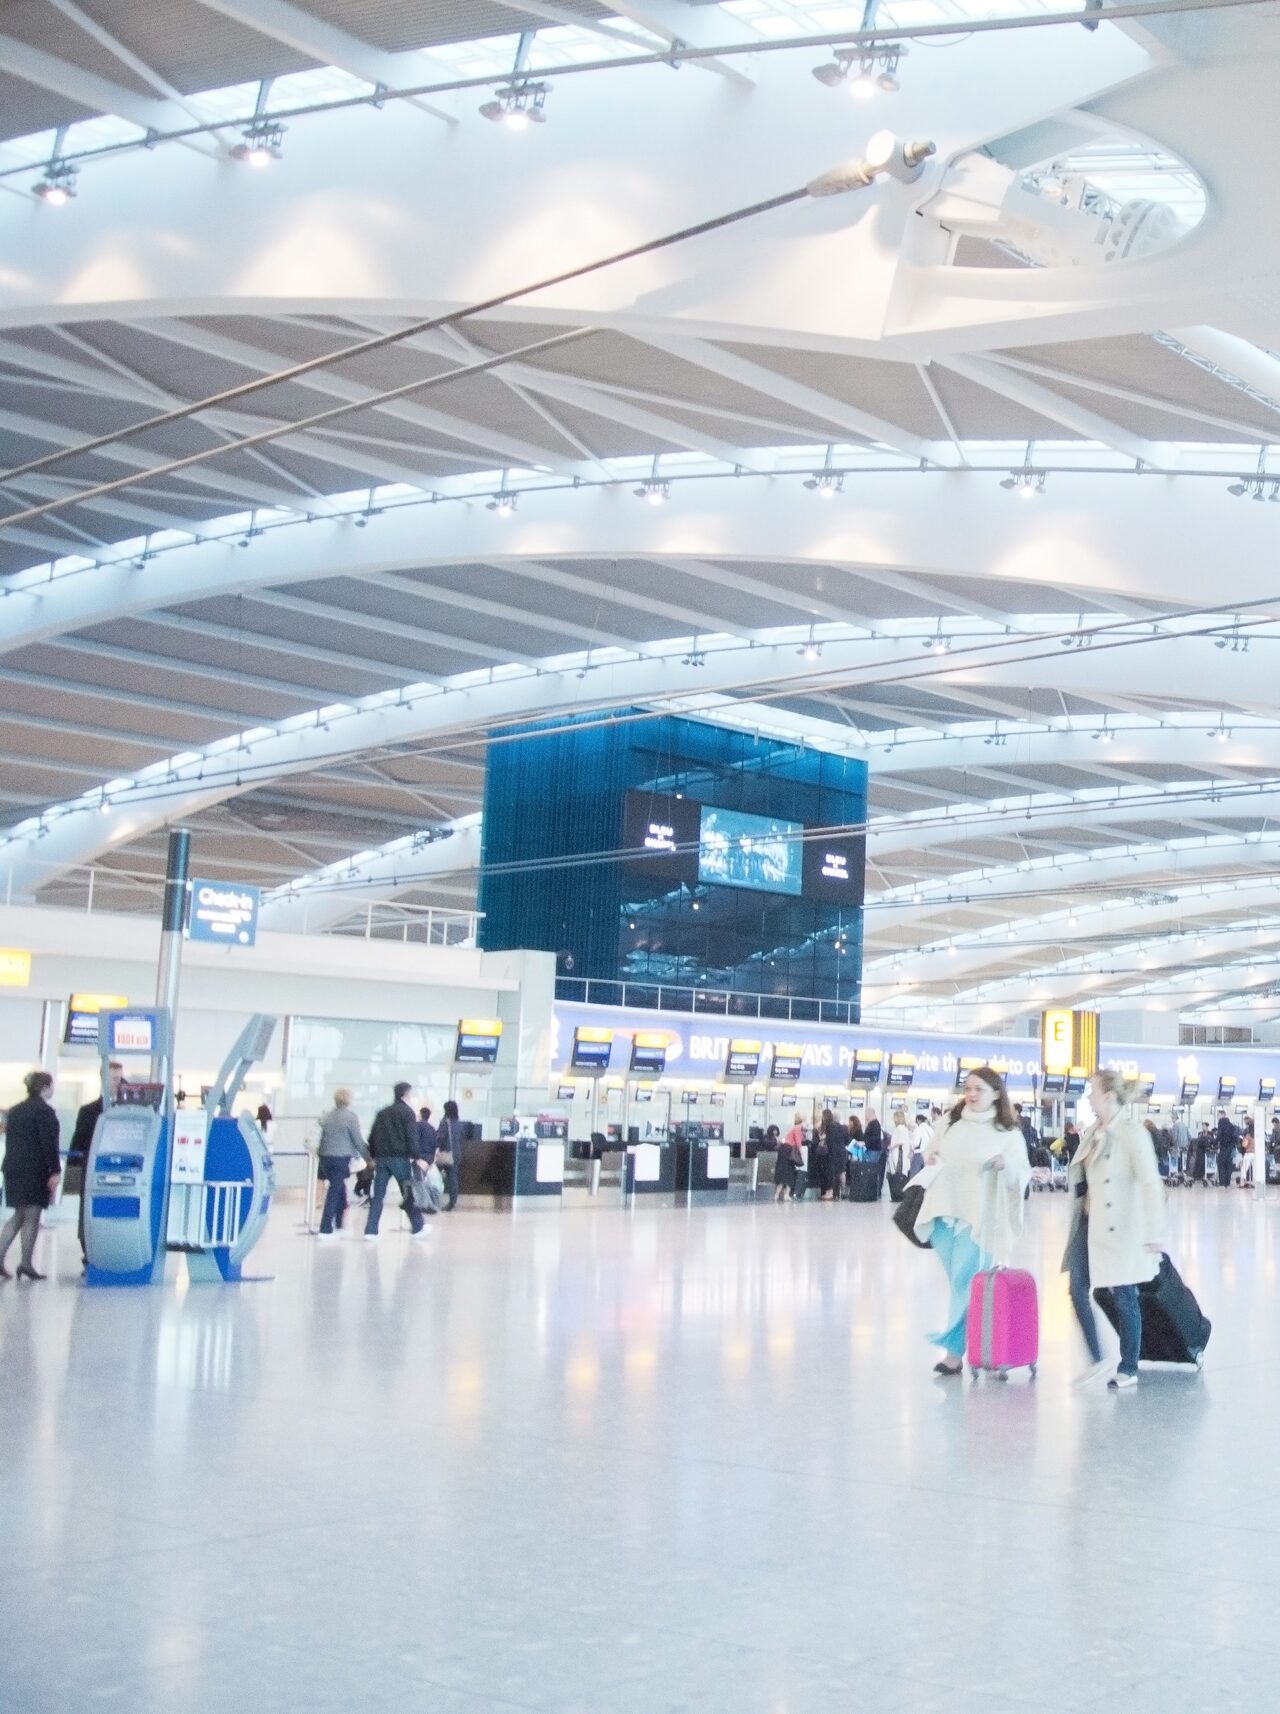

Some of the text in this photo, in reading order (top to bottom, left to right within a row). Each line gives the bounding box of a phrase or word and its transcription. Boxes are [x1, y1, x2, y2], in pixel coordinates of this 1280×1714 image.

[1054, 1021, 1065, 1041] E
[761, 1040, 833, 1066] AAYS
[1008, 1058, 1023, 1076] to
[1026, 1059, 1043, 1076] ou
